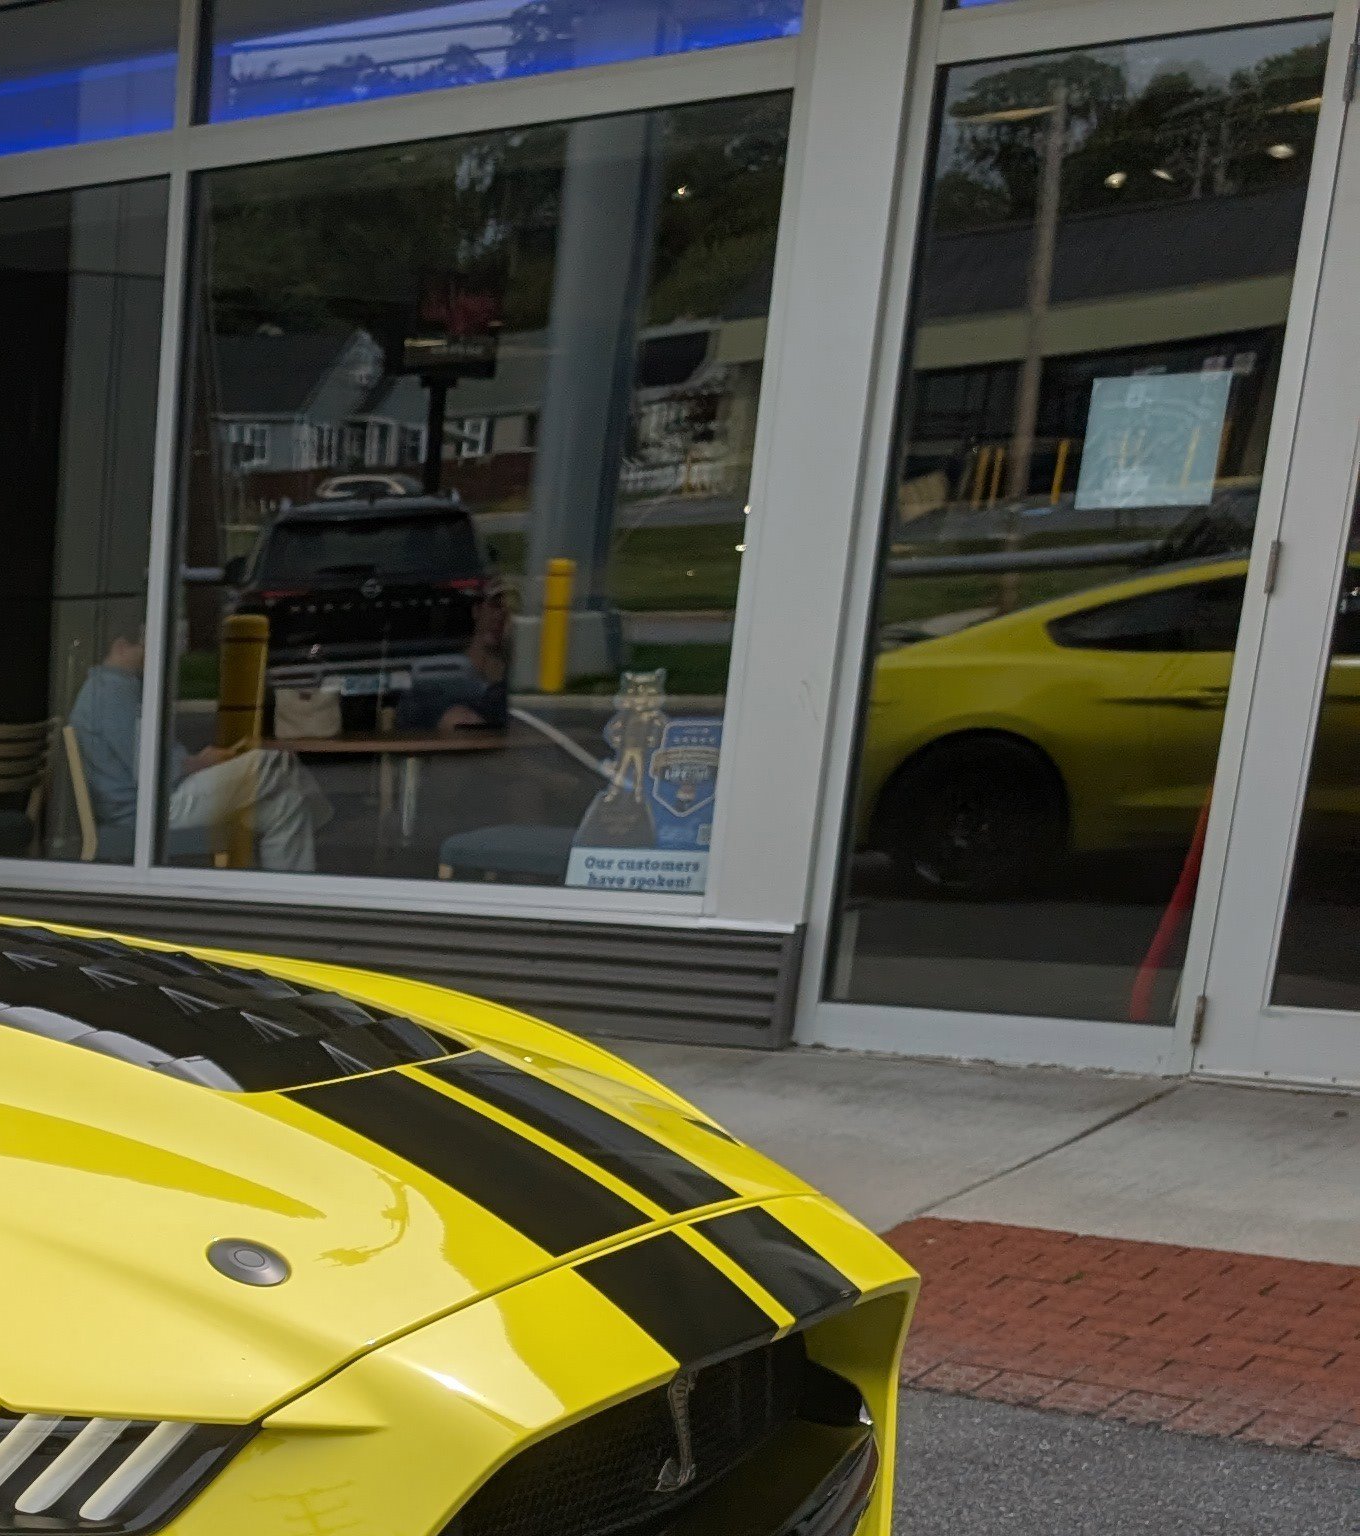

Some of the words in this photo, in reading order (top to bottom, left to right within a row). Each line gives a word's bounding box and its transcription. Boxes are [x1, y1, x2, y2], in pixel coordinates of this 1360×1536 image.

[584, 856, 614, 870] Our
[617, 857, 700, 873] customers
[587, 872, 625, 887] have
[629, 875, 693, 890] spoken!
